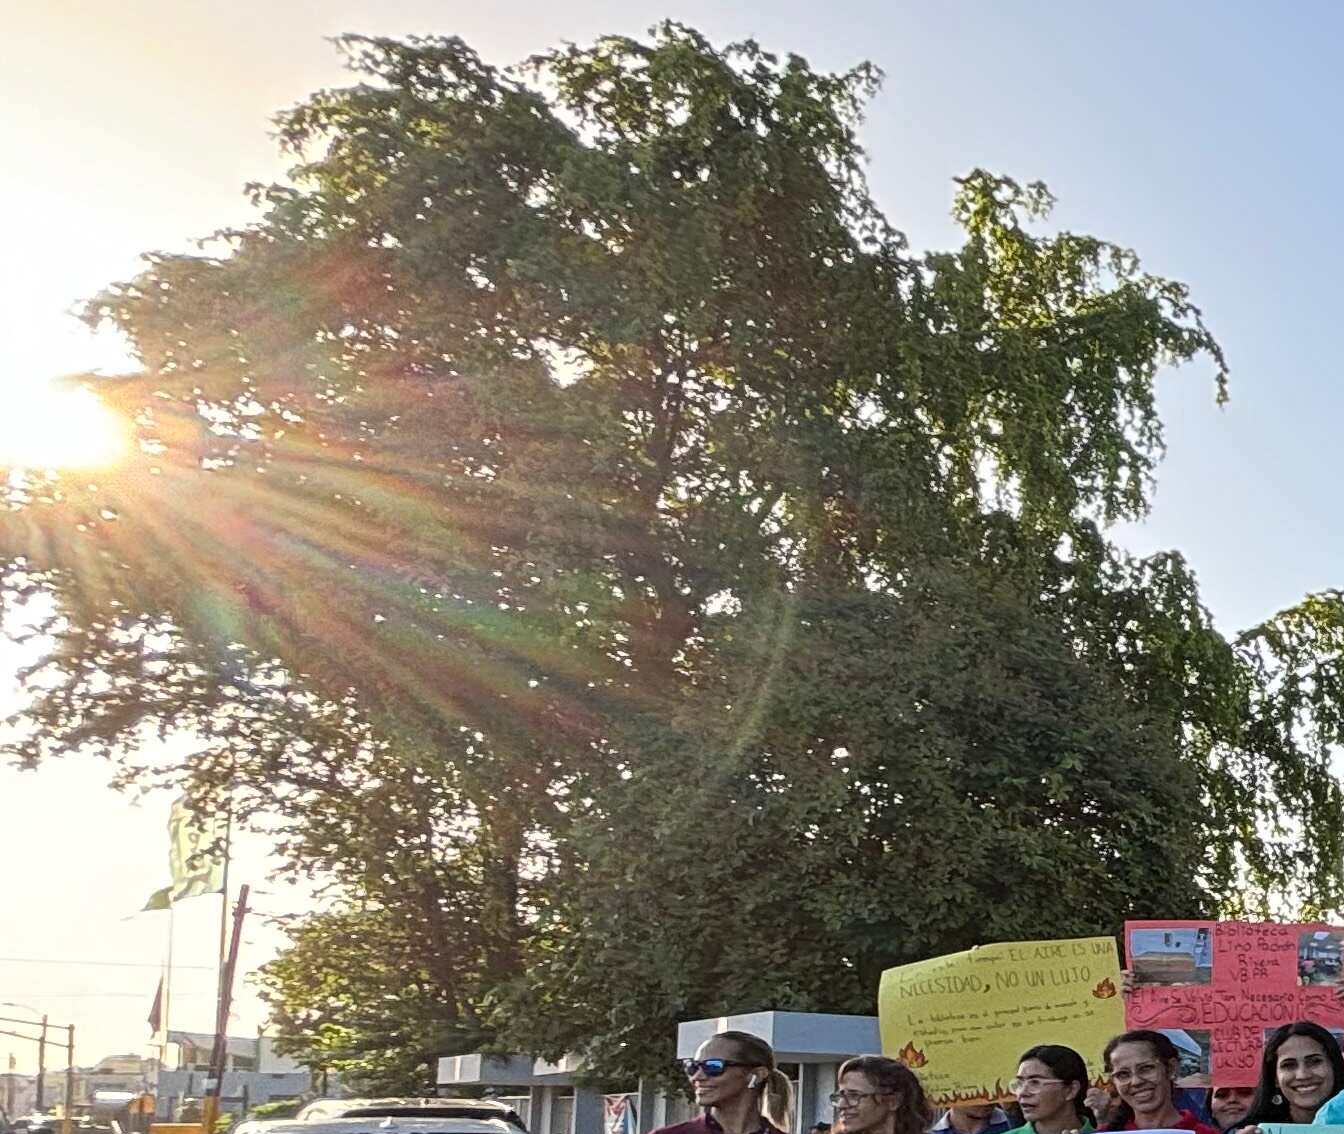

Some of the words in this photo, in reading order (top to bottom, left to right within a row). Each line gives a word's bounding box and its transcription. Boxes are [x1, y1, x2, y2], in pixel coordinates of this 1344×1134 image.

[995, 971, 1019, 988] NO
[1025, 969, 1046, 987] UN
[1051, 965, 1091, 985] LUJO
